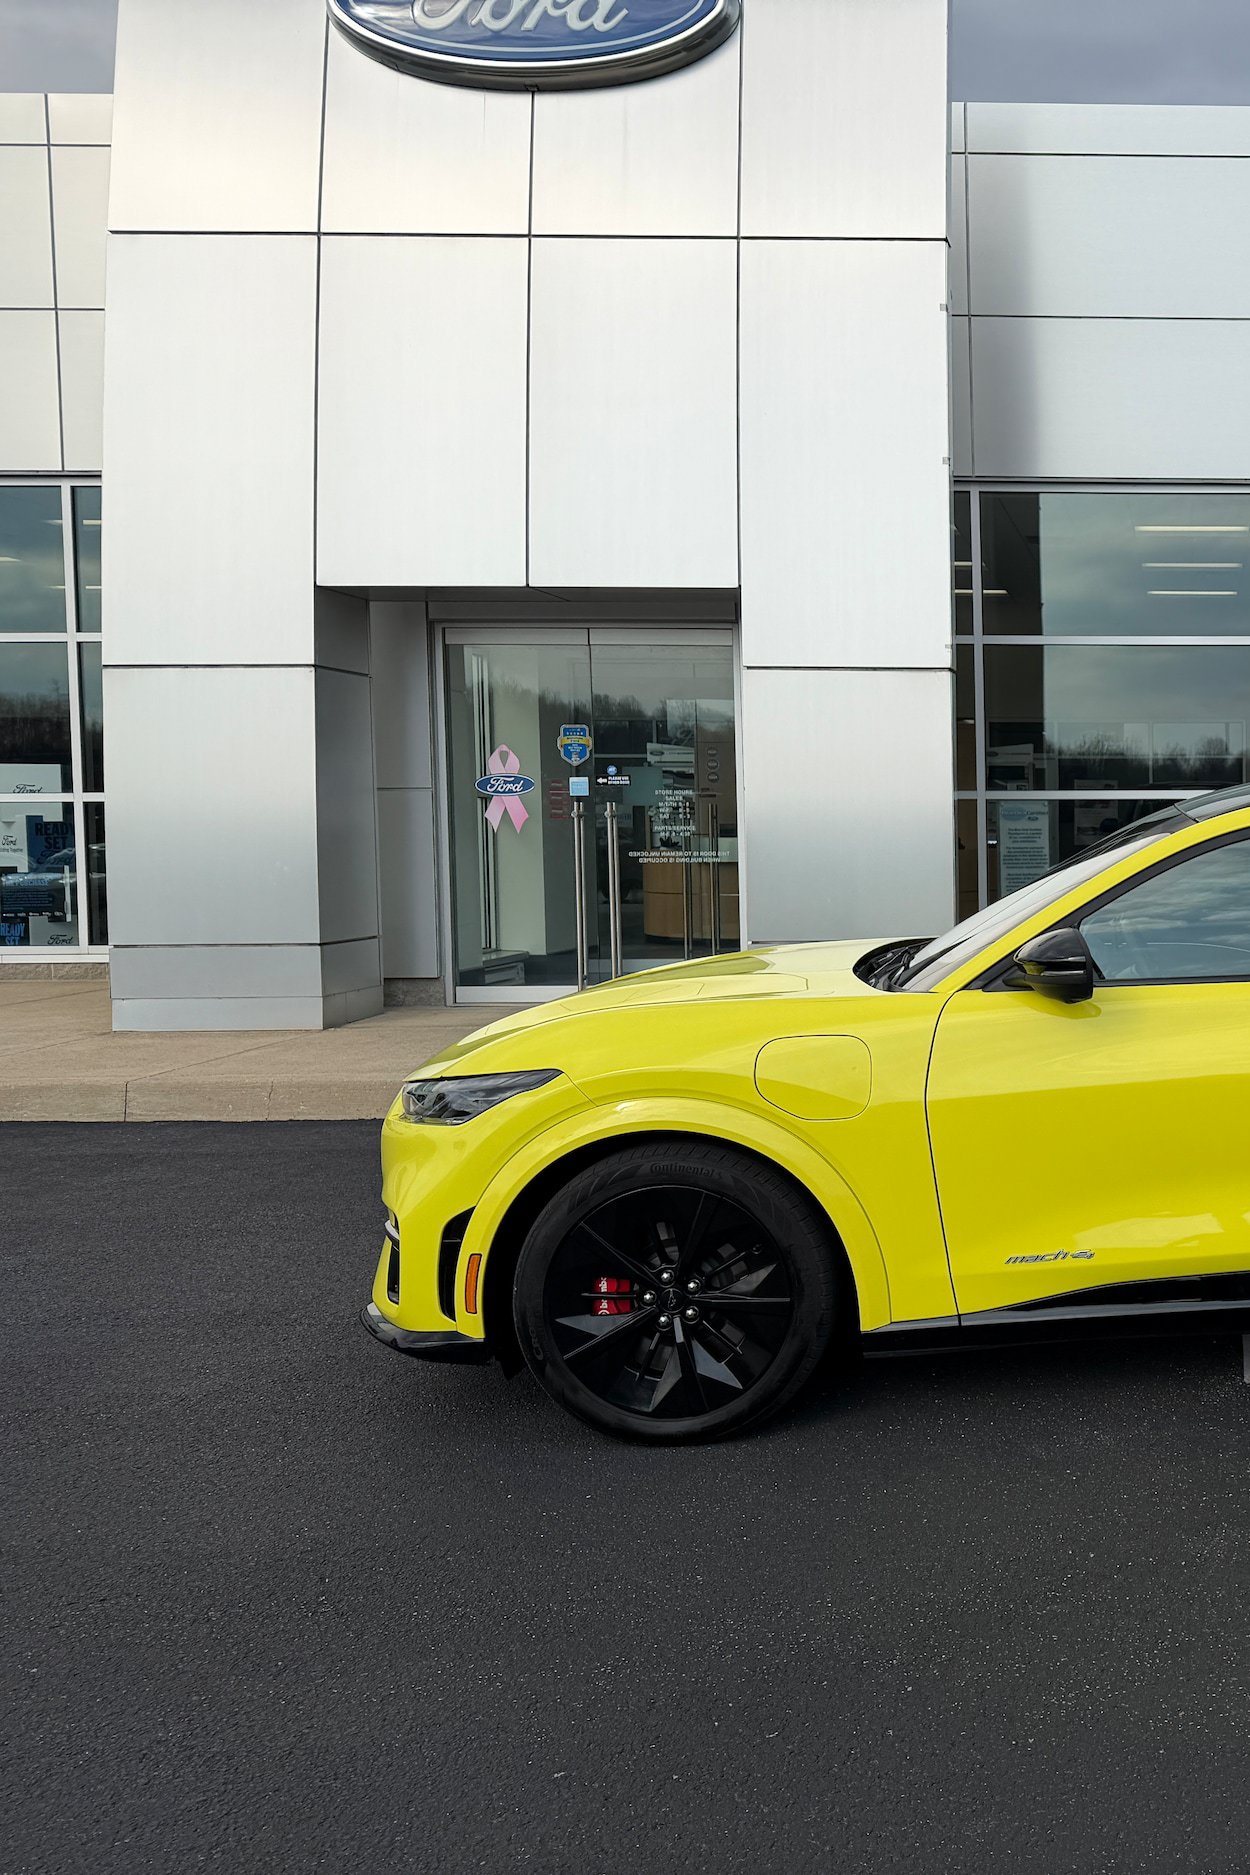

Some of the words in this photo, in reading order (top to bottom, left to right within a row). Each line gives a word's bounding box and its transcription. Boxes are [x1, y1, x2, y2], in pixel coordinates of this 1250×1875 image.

[486, 776, 525, 793] Ford
[2, 834, 18, 846] Ford
[44, 837, 68, 850] SET
[0, 922, 26, 937] READY
[47, 934, 74, 946] Ford
[650, 1161, 715, 1178] Continental
